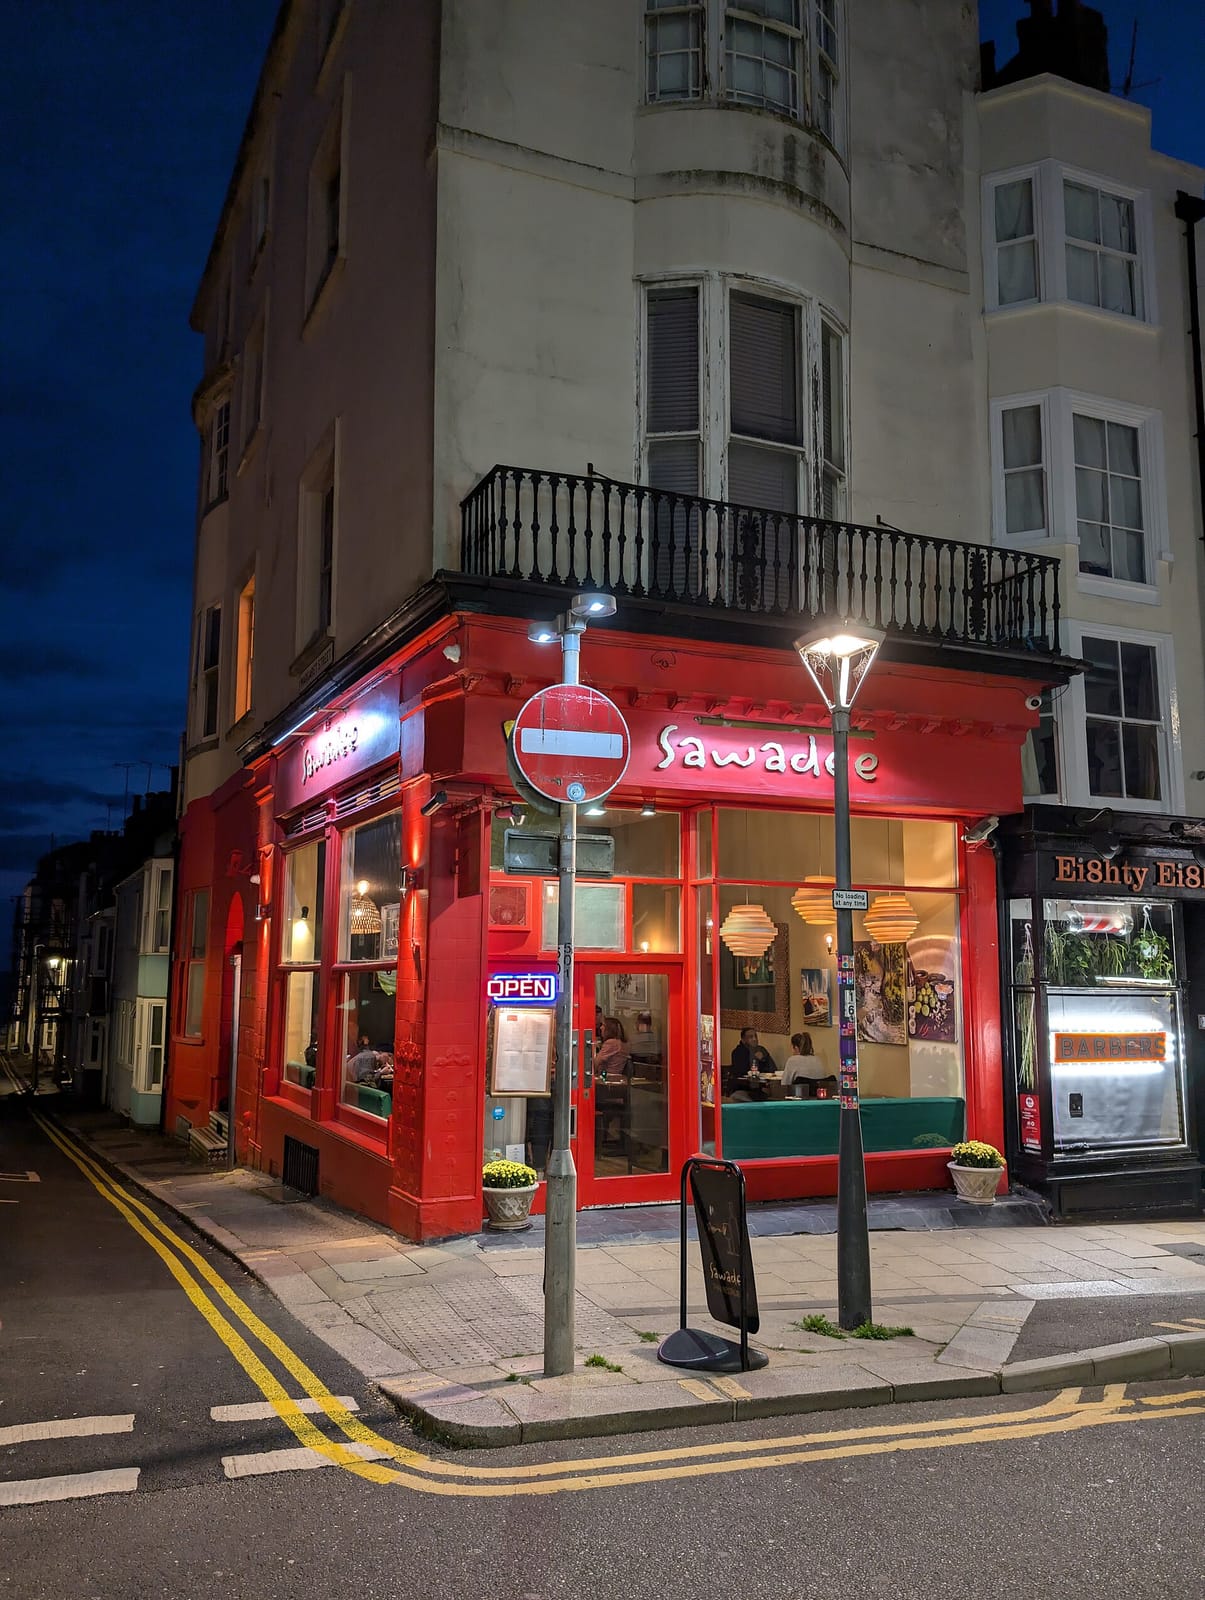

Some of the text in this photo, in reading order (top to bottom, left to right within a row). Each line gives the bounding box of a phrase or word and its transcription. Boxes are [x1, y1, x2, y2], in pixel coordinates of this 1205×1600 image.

[1055, 855, 1205, 893] Ei8hty Ei8
[487, 980, 550, 997] OPEN
[1061, 1036, 1166, 1059] BARBERS
